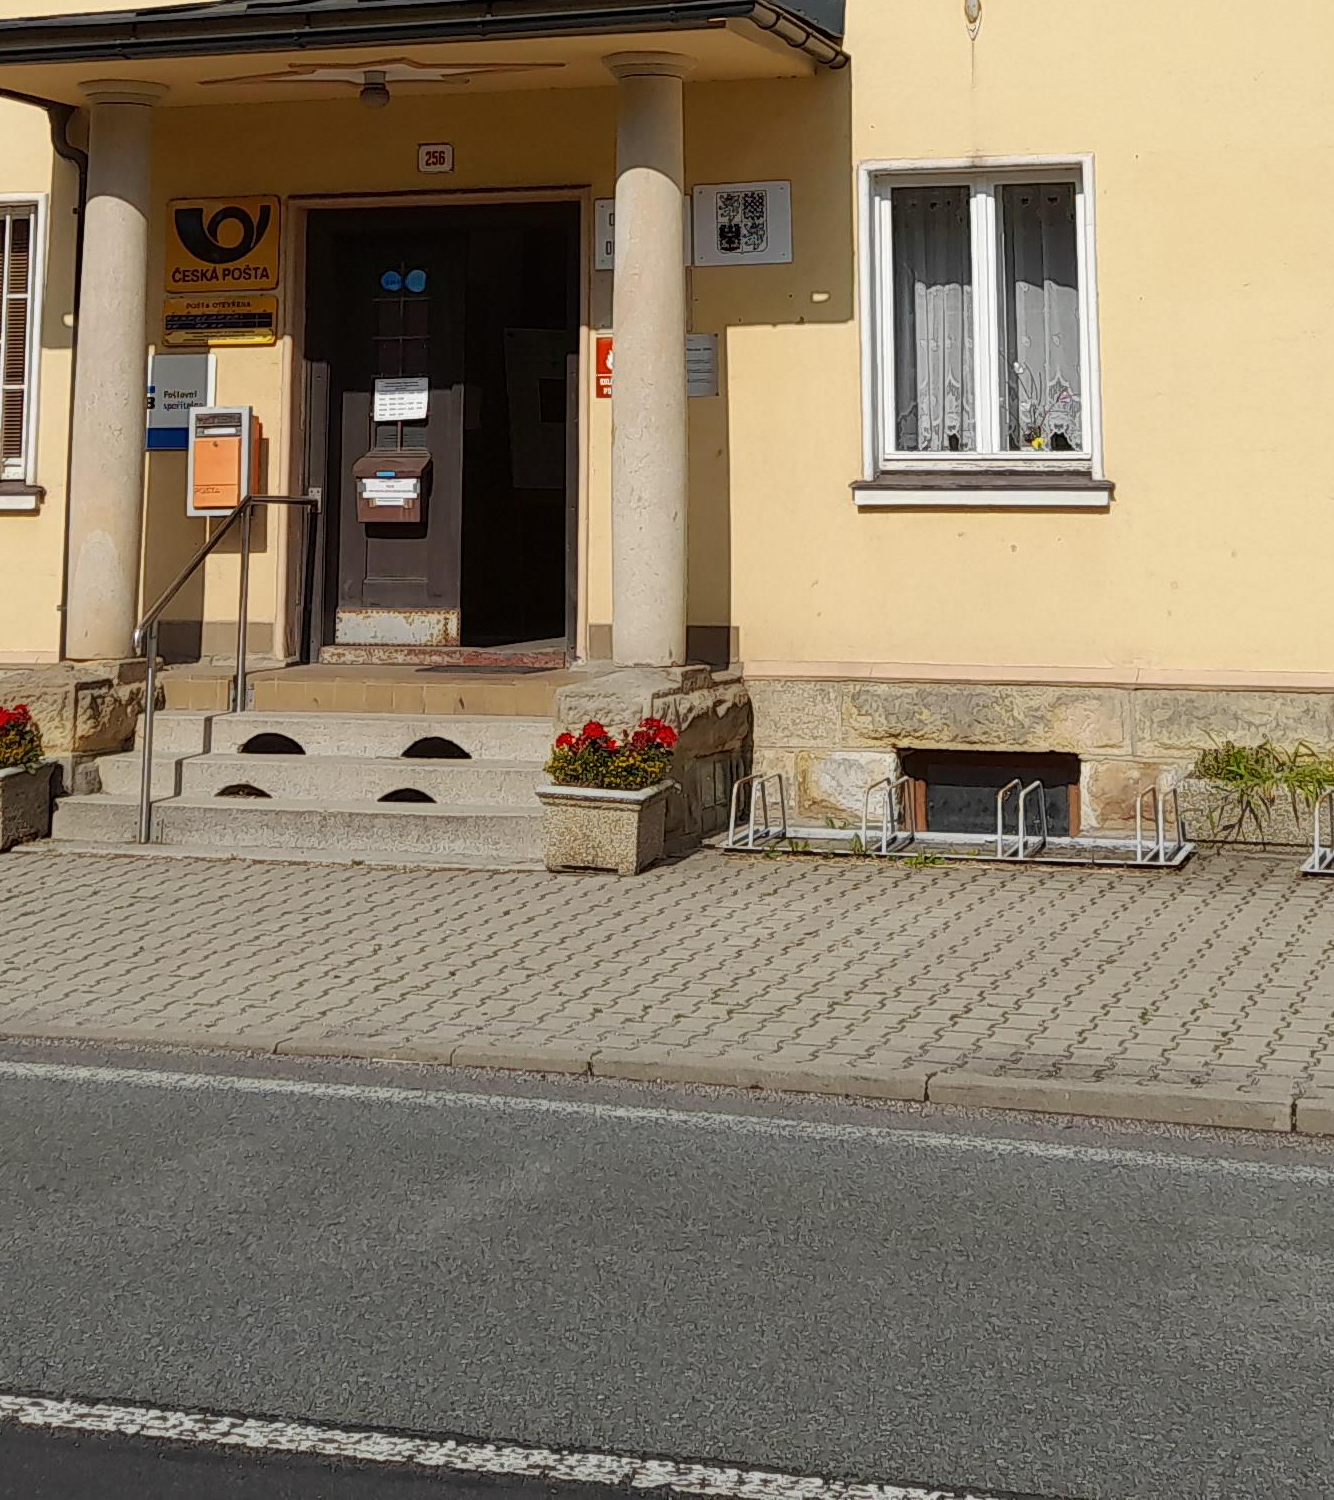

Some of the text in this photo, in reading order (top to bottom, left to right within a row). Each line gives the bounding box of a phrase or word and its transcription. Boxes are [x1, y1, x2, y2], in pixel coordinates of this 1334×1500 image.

[425, 151, 445, 166] 256
[172, 264, 269, 283] ČESKÁ POŠTA
